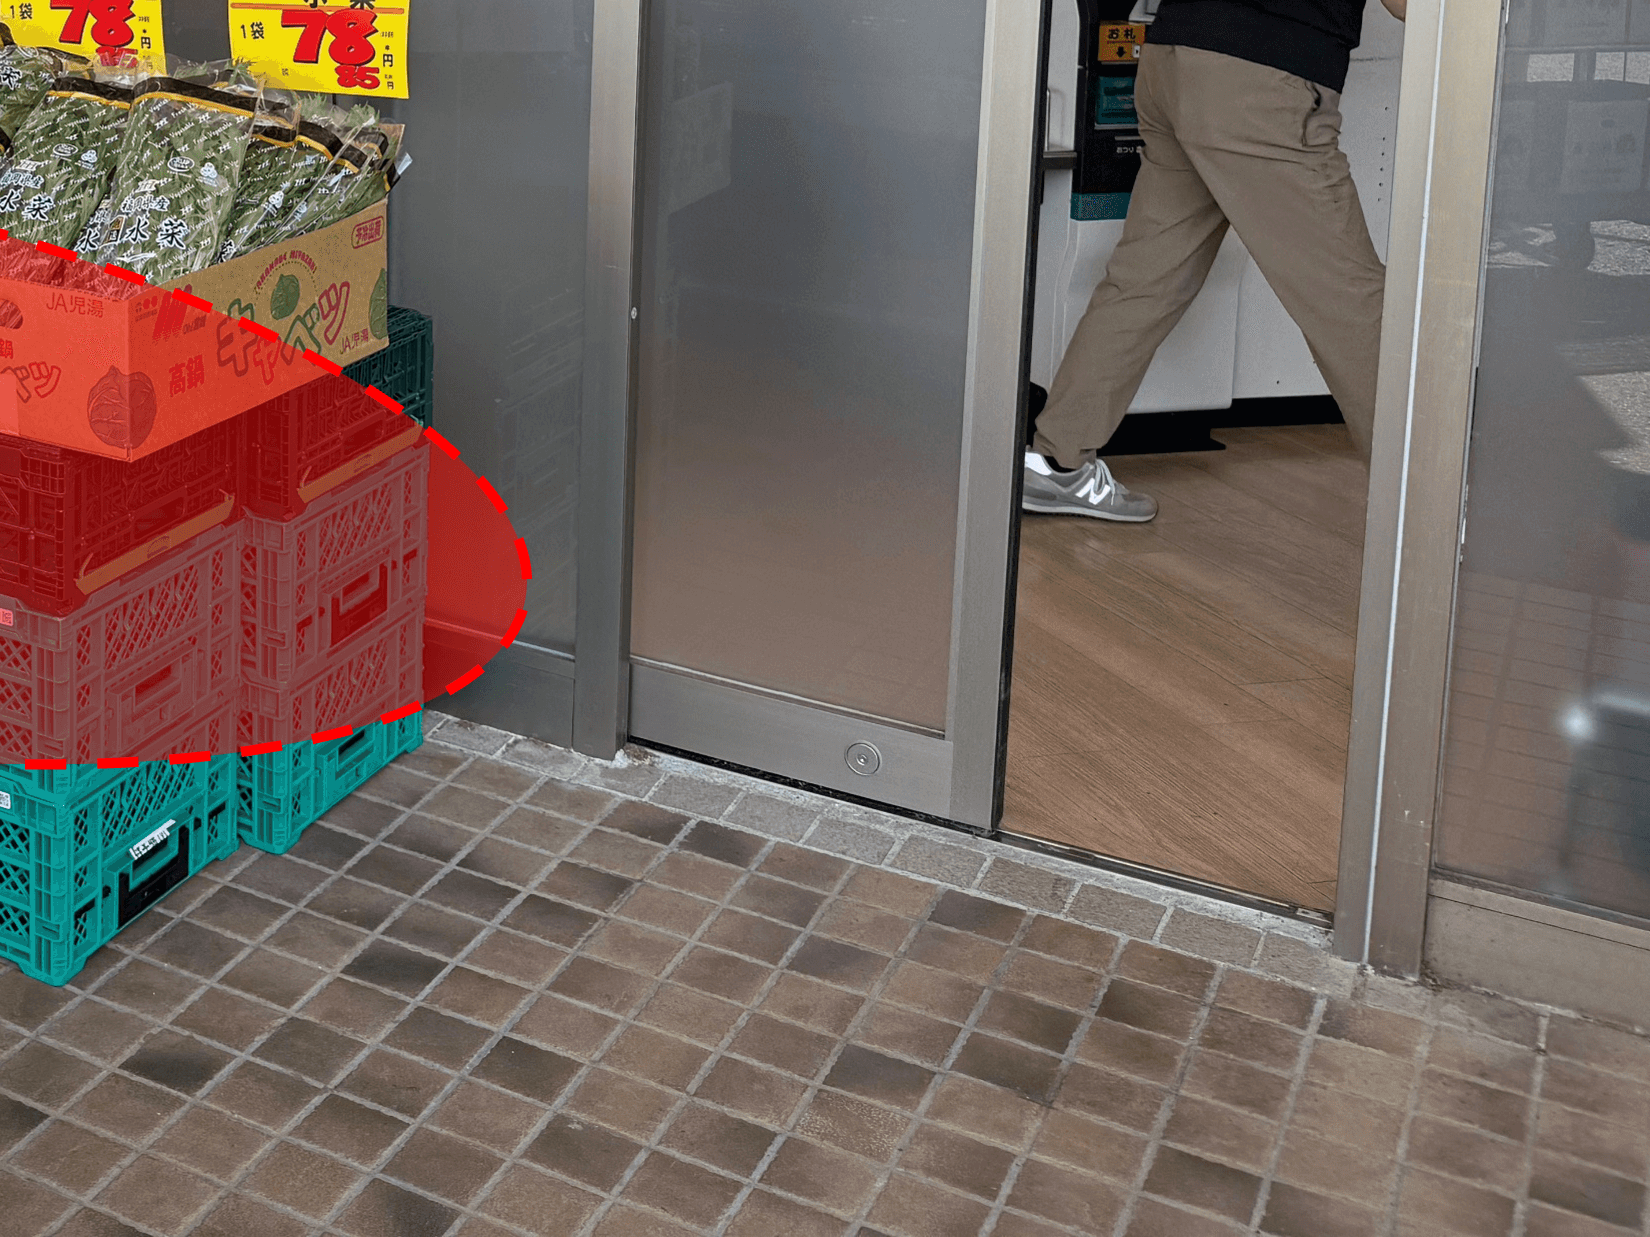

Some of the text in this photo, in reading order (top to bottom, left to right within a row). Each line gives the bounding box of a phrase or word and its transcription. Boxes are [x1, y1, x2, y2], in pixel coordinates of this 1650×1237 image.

[9, 2, 33, 20] 1袋
[240, 21, 265, 40] 1袋
[281, 8, 379, 66] 78
[1108, 28, 1136, 41] お札
[140, 36, 152, 49] 円
[383, 54, 393, 67] 円
[334, 64, 380, 90] 85
[121, 194, 170, 211] 福岡県産
[125, 217, 189, 249] 水菜
[46, 292, 104, 319] JA児湯
[339, 328, 369, 355] JA児湯
[168, 354, 205, 398] 高鍋
